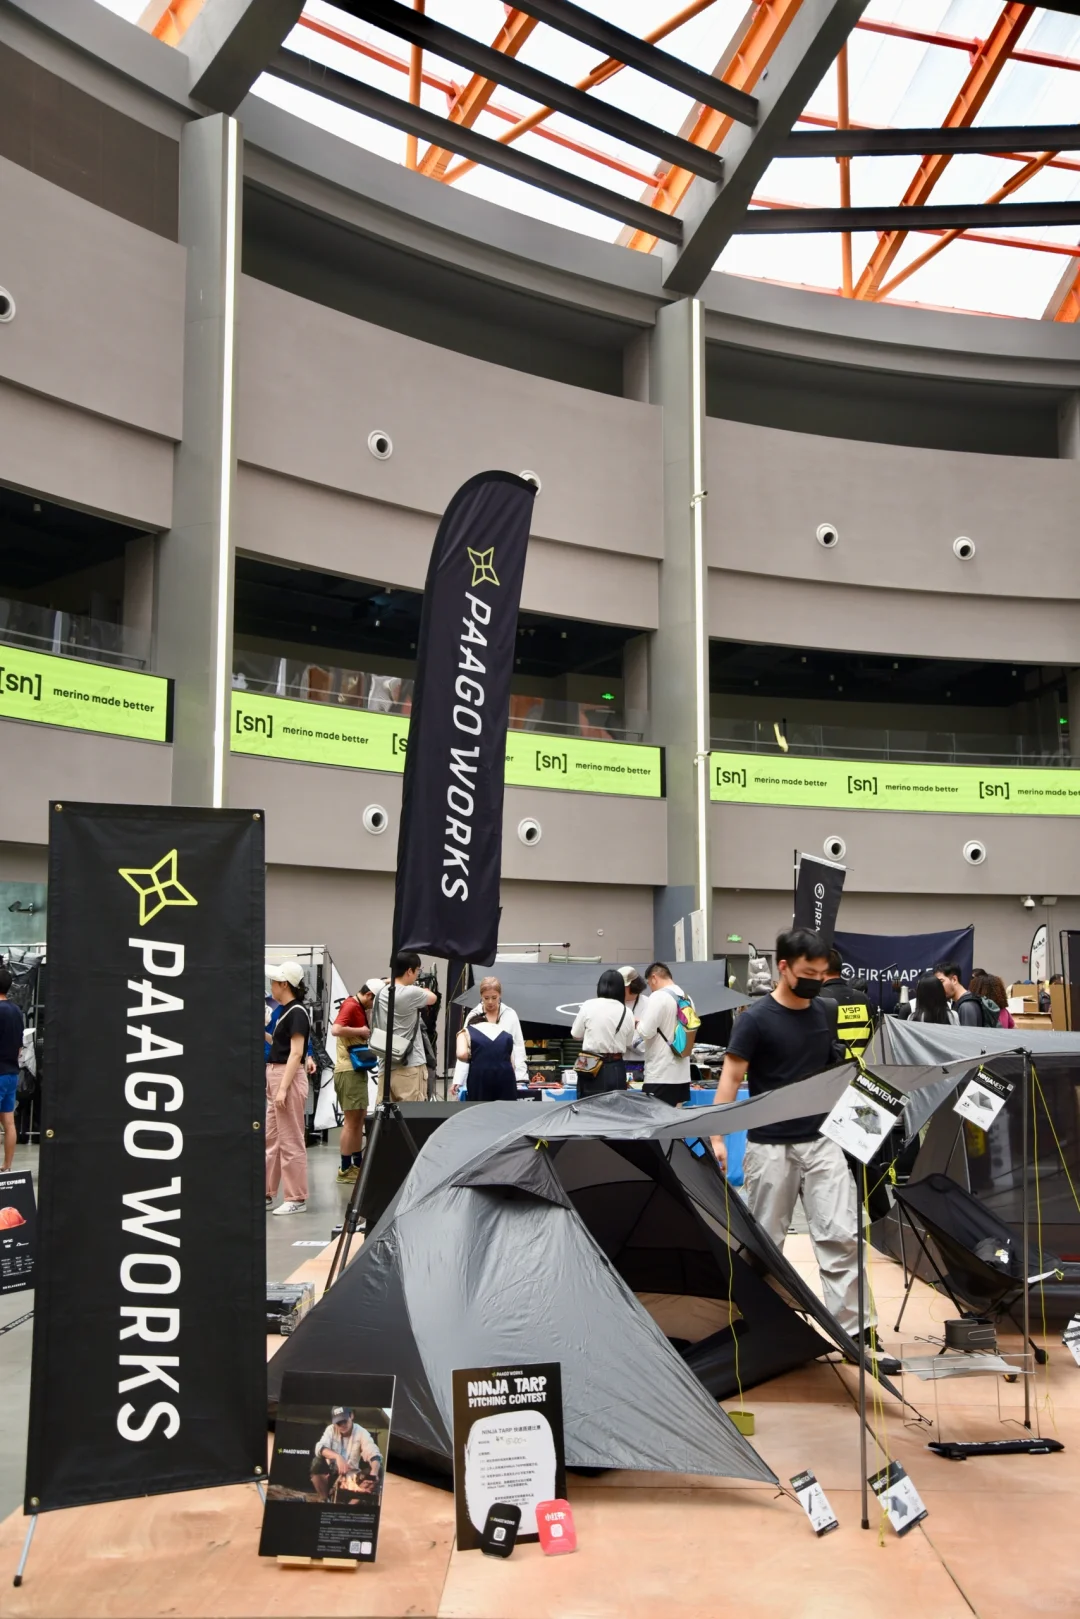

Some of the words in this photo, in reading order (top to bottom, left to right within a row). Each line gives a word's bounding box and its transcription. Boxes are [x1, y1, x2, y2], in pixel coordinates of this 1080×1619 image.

[453, 591, 492, 737] PAAGO
[0, 666, 42, 701] [sn]
[53, 688, 90, 701] merino
[92, 694, 121, 707] made
[123, 699, 155, 712] better
[236, 710, 273, 738] [sn]
[282, 725, 313, 737] merino
[315, 731, 340, 741] made
[342, 733, 369, 745] better
[535, 750, 567, 774] [sn]
[575, 762, 602, 771] merino
[604, 765, 625, 774] made
[627, 766, 651, 776] better
[716, 767, 746, 788] [sn]
[754, 776, 780, 785] merino
[781, 778, 803, 786] made
[804, 778, 827, 787] better
[847, 775, 878, 795] [sn]
[885, 783, 911, 791] merino
[935, 785, 959, 793] better
[979, 781, 1010, 800] [sn]
[1017, 788, 1044, 796] merino
[441, 745, 480, 902] WORKS
[857, 967, 934, 982] FIREMAP
[842, 1006, 861, 1014] VSP
[122, 937, 186, 1161] PAAGO
[116, 1175, 182, 1443] WORKS
[467, 1379, 509, 1397] NINJA
[514, 1375, 547, 1393] TARP
[468, 1395, 507, 1408] PITCHING
[508, 1391, 547, 1405] CONTEST
